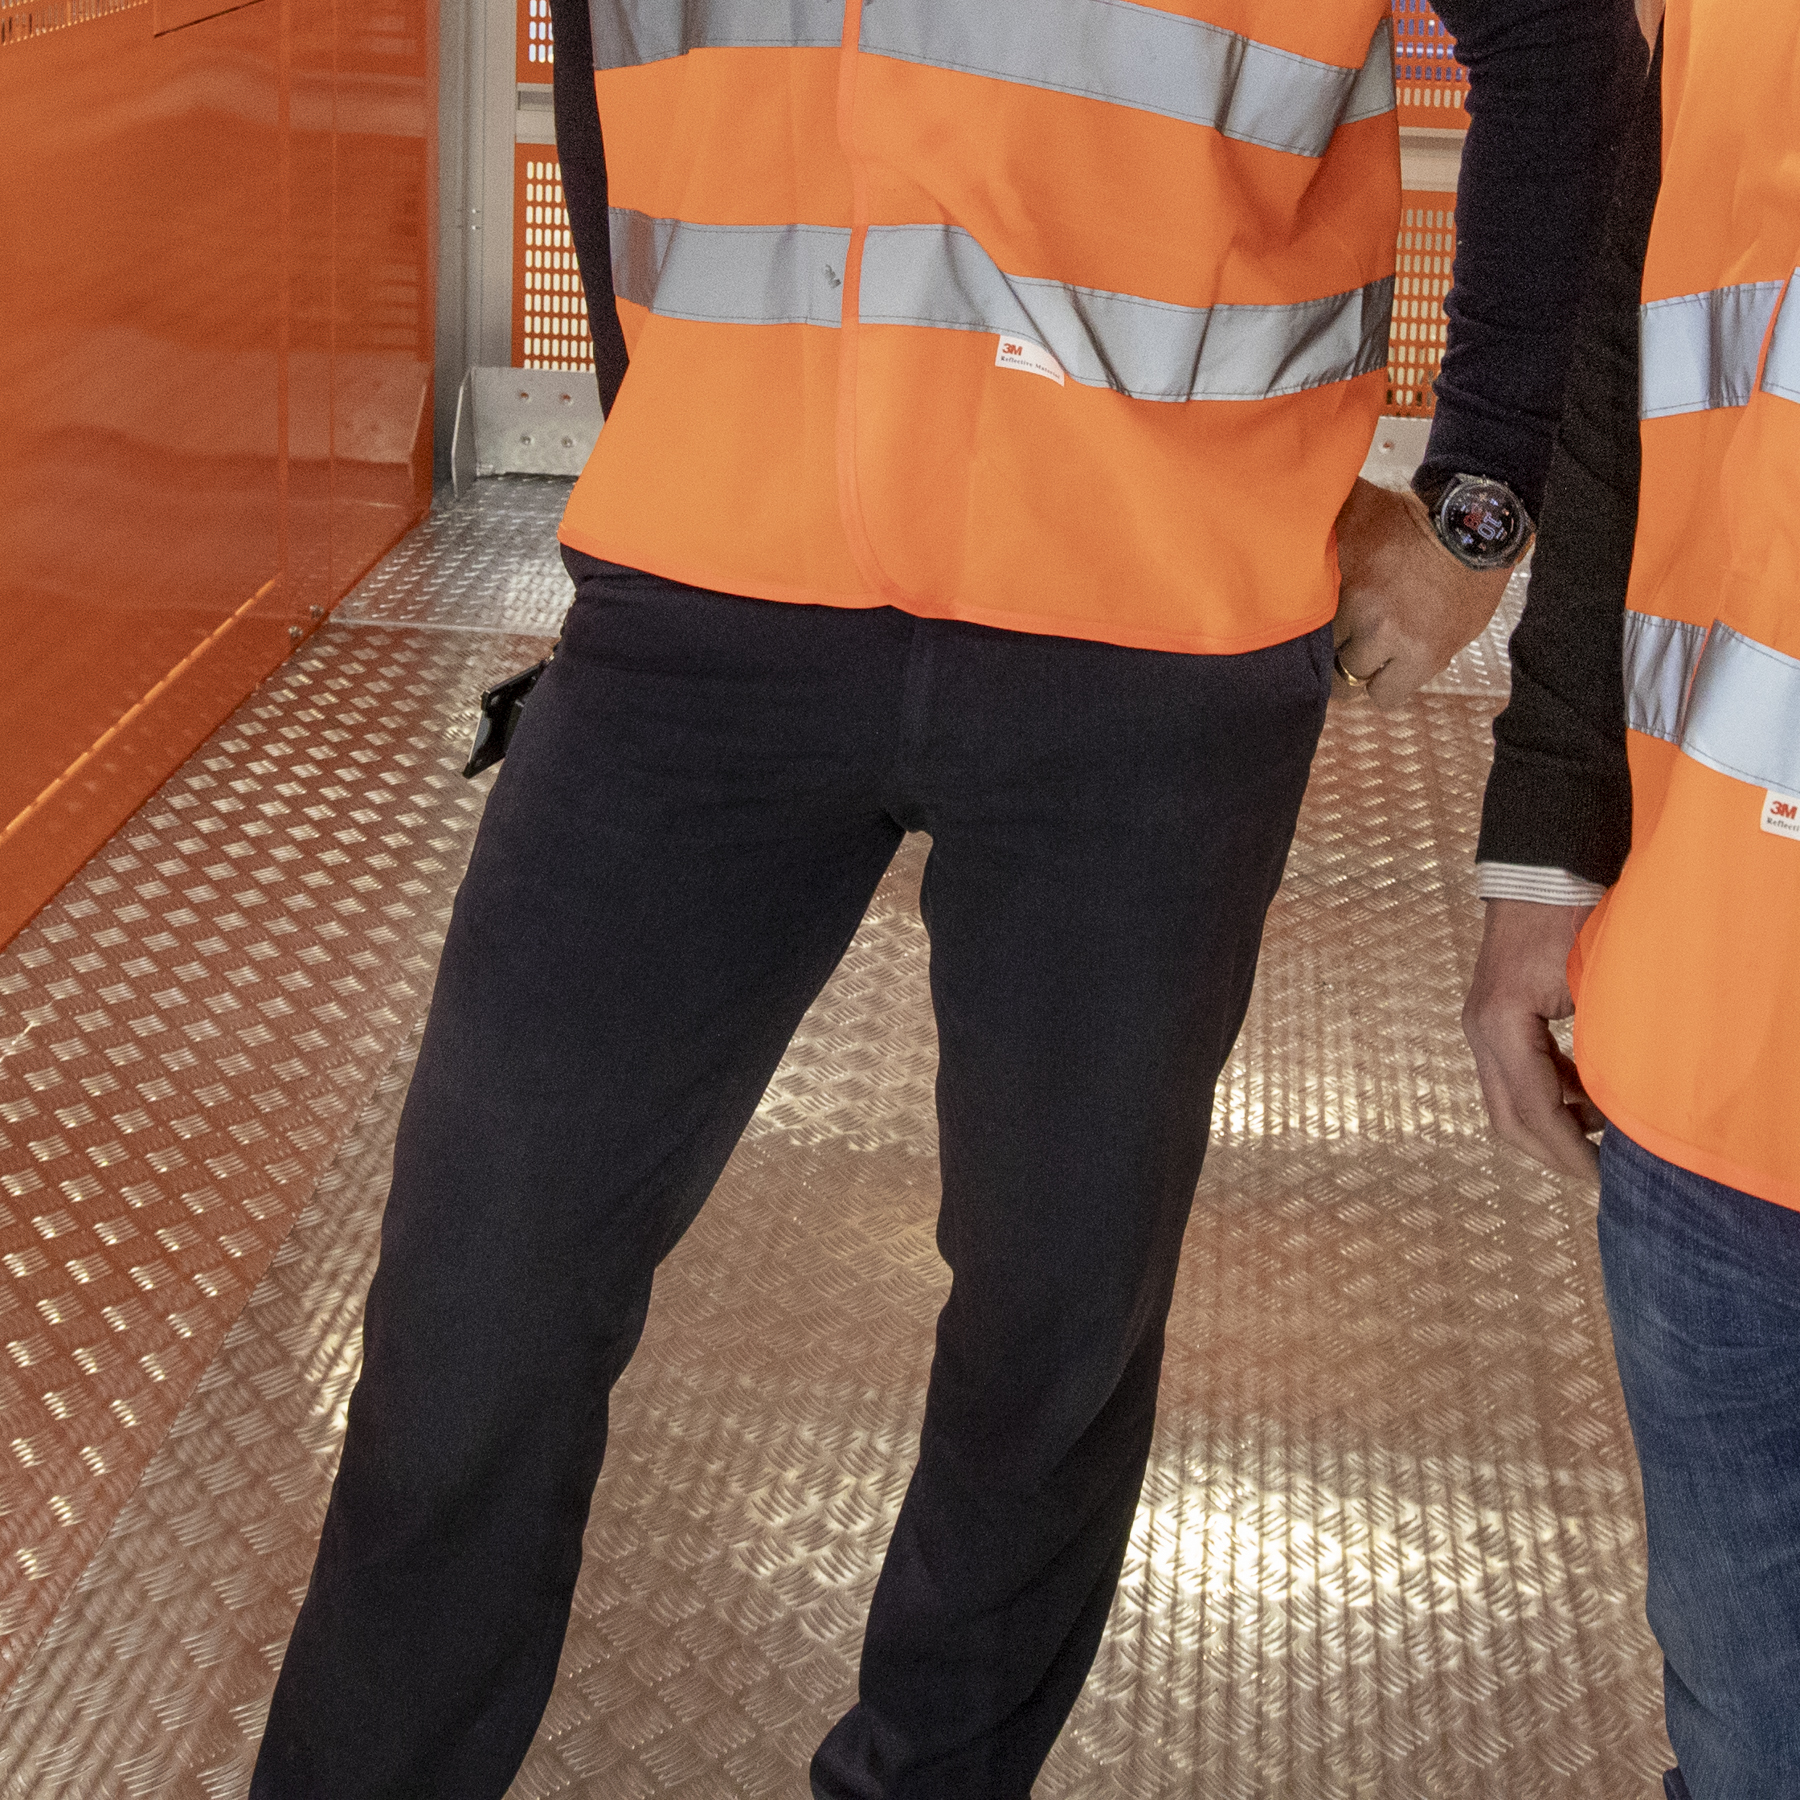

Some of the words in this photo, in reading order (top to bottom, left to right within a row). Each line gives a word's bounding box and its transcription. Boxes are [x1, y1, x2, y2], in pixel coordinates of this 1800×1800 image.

[1002, 343, 1023, 356] 3M
[1001, 356, 1033, 367] Reflective
[1035, 363, 1060, 379] Material
[1770, 800, 1798, 820] 3M
